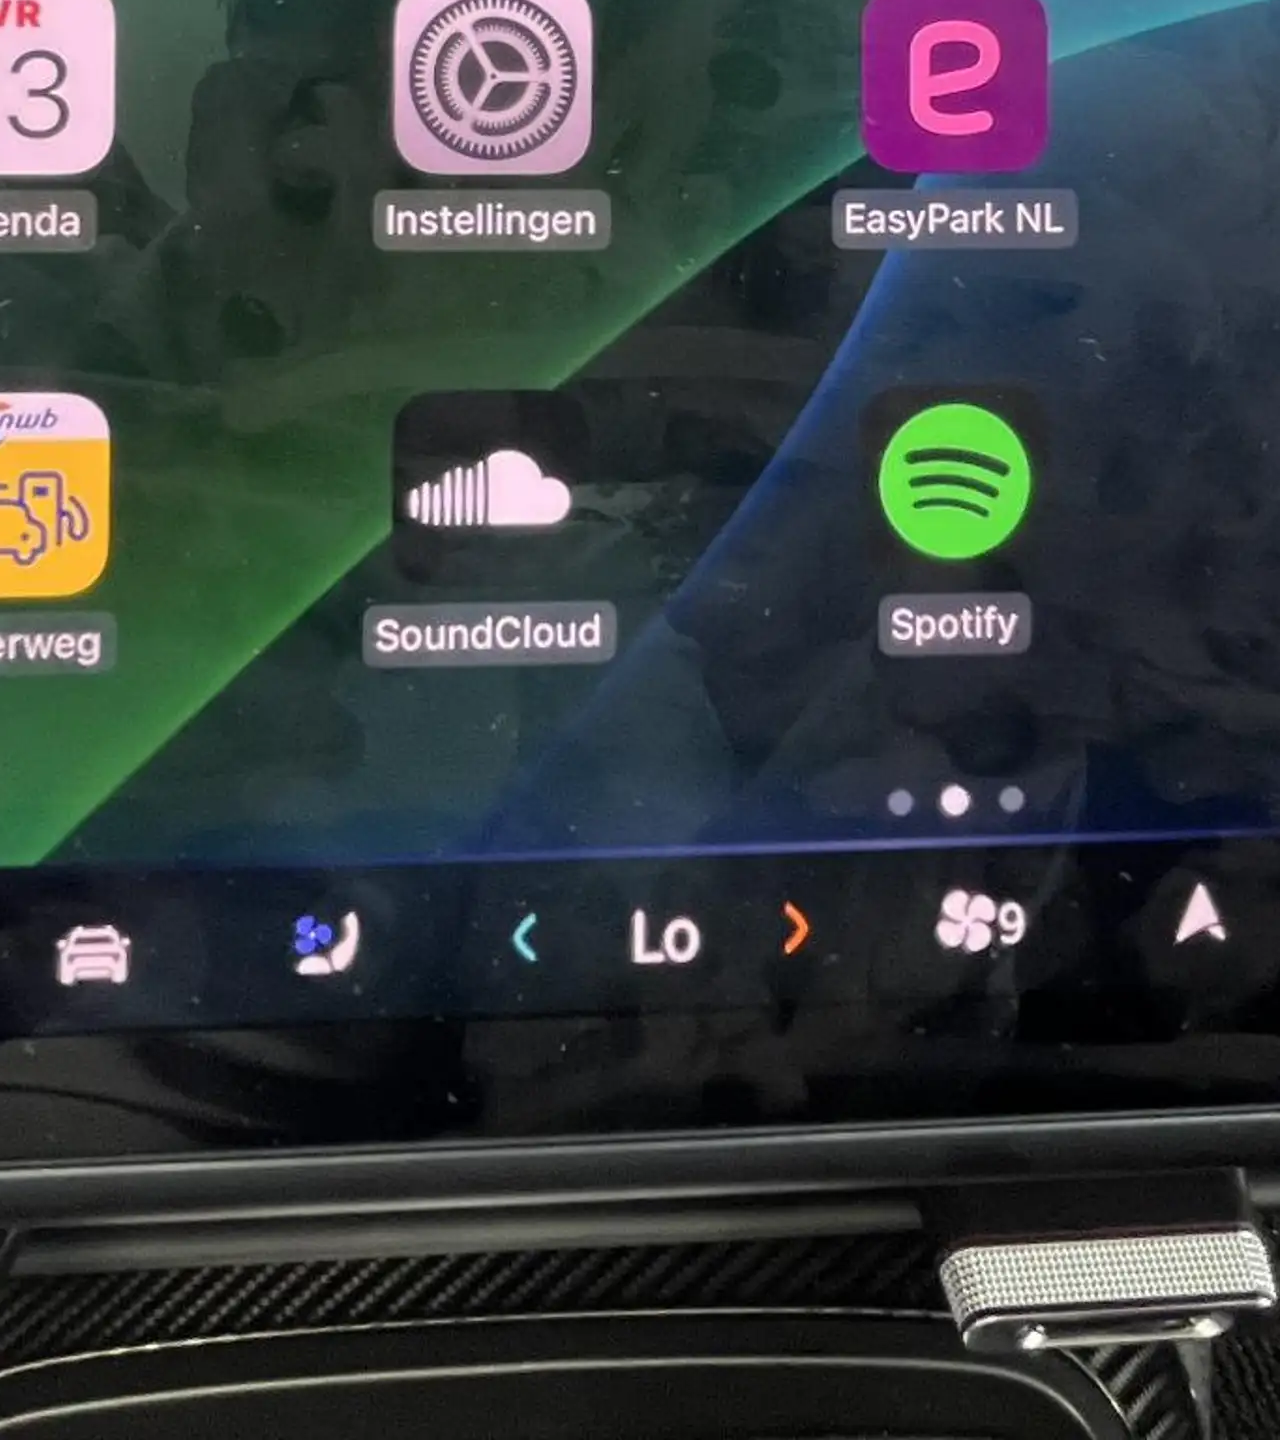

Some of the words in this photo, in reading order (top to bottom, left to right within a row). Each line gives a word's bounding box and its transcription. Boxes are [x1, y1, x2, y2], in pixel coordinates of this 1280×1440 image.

[385, 204, 597, 243] Instellingen
[844, 202, 1006, 242] EasyPark
[1017, 203, 1064, 234] NL
[375, 614, 602, 652] SoundCloud
[890, 606, 1019, 646] Spotify
[999, 902, 1025, 945] 9
